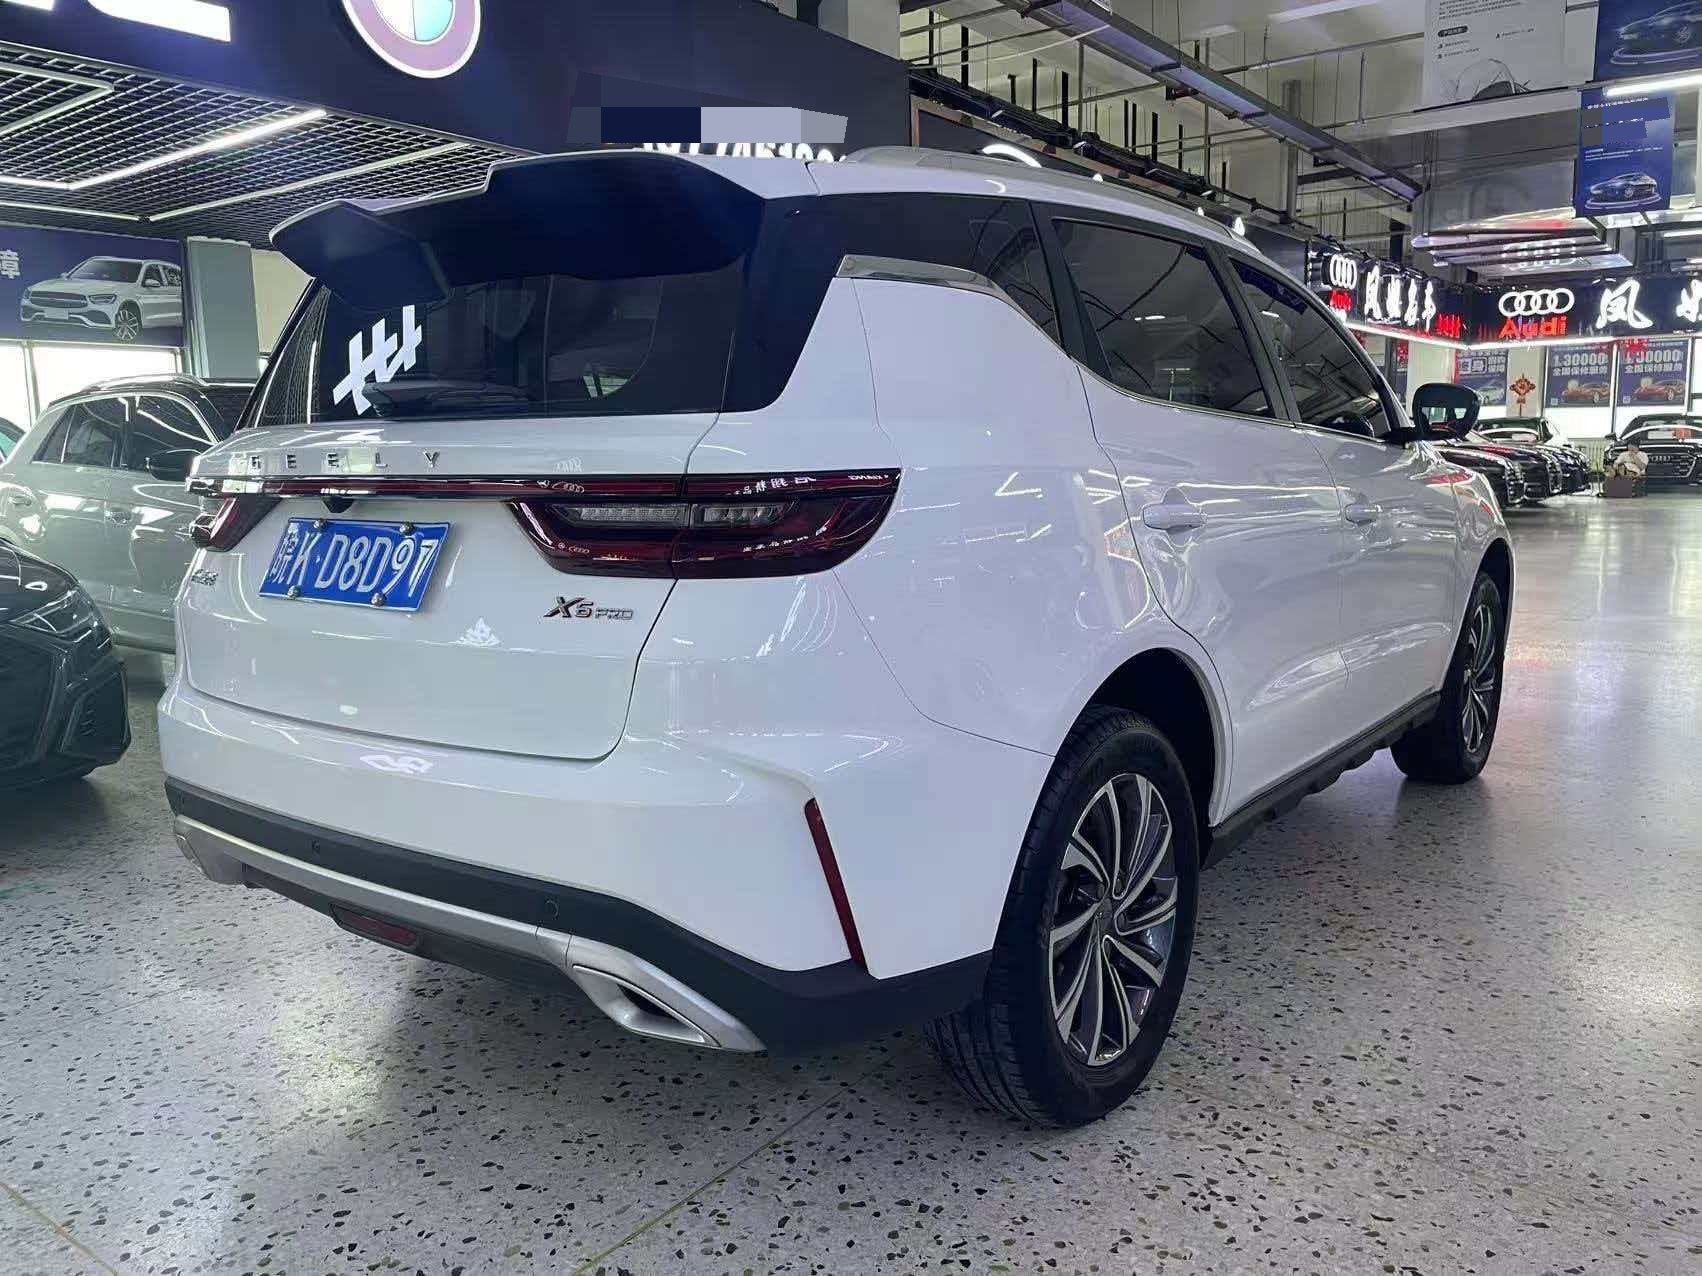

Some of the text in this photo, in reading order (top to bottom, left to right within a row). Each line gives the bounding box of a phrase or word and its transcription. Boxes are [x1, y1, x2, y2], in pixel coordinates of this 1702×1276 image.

[1499, 315, 1567, 339] Audi
[250, 451, 440, 469] GEELY
[595, 608, 633, 620] PRO
